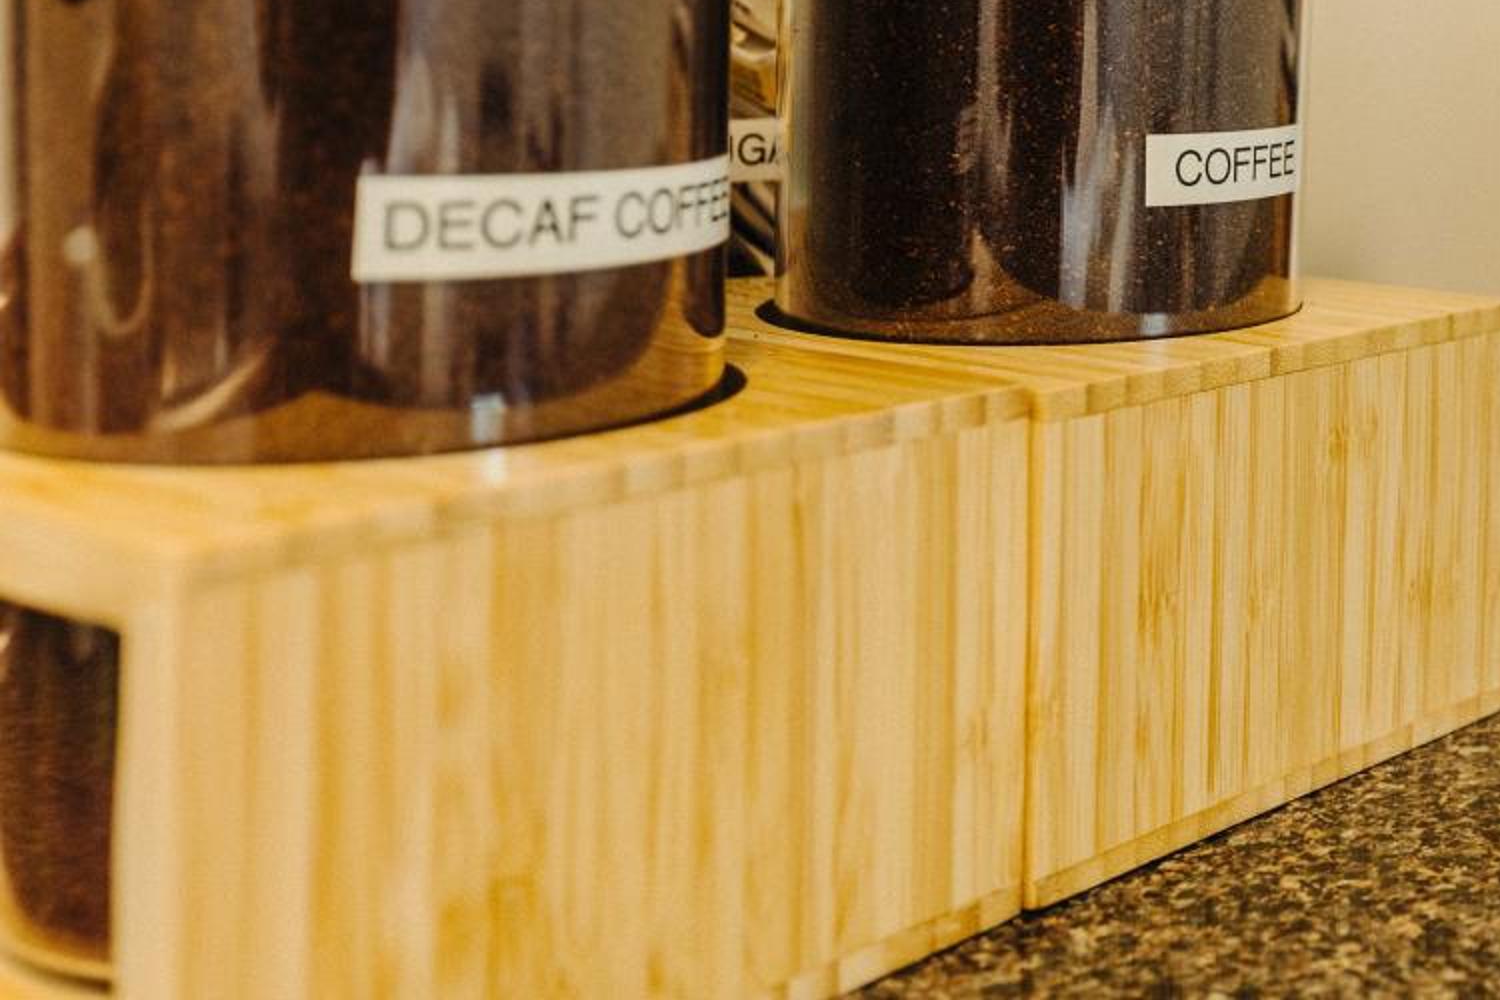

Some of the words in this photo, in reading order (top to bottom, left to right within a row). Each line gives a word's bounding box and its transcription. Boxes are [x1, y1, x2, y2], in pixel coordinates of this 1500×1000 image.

[1175, 140, 1296, 187] COFFEE
[384, 195, 600, 251] DECAF
[615, 176, 729, 239] COFFEE
